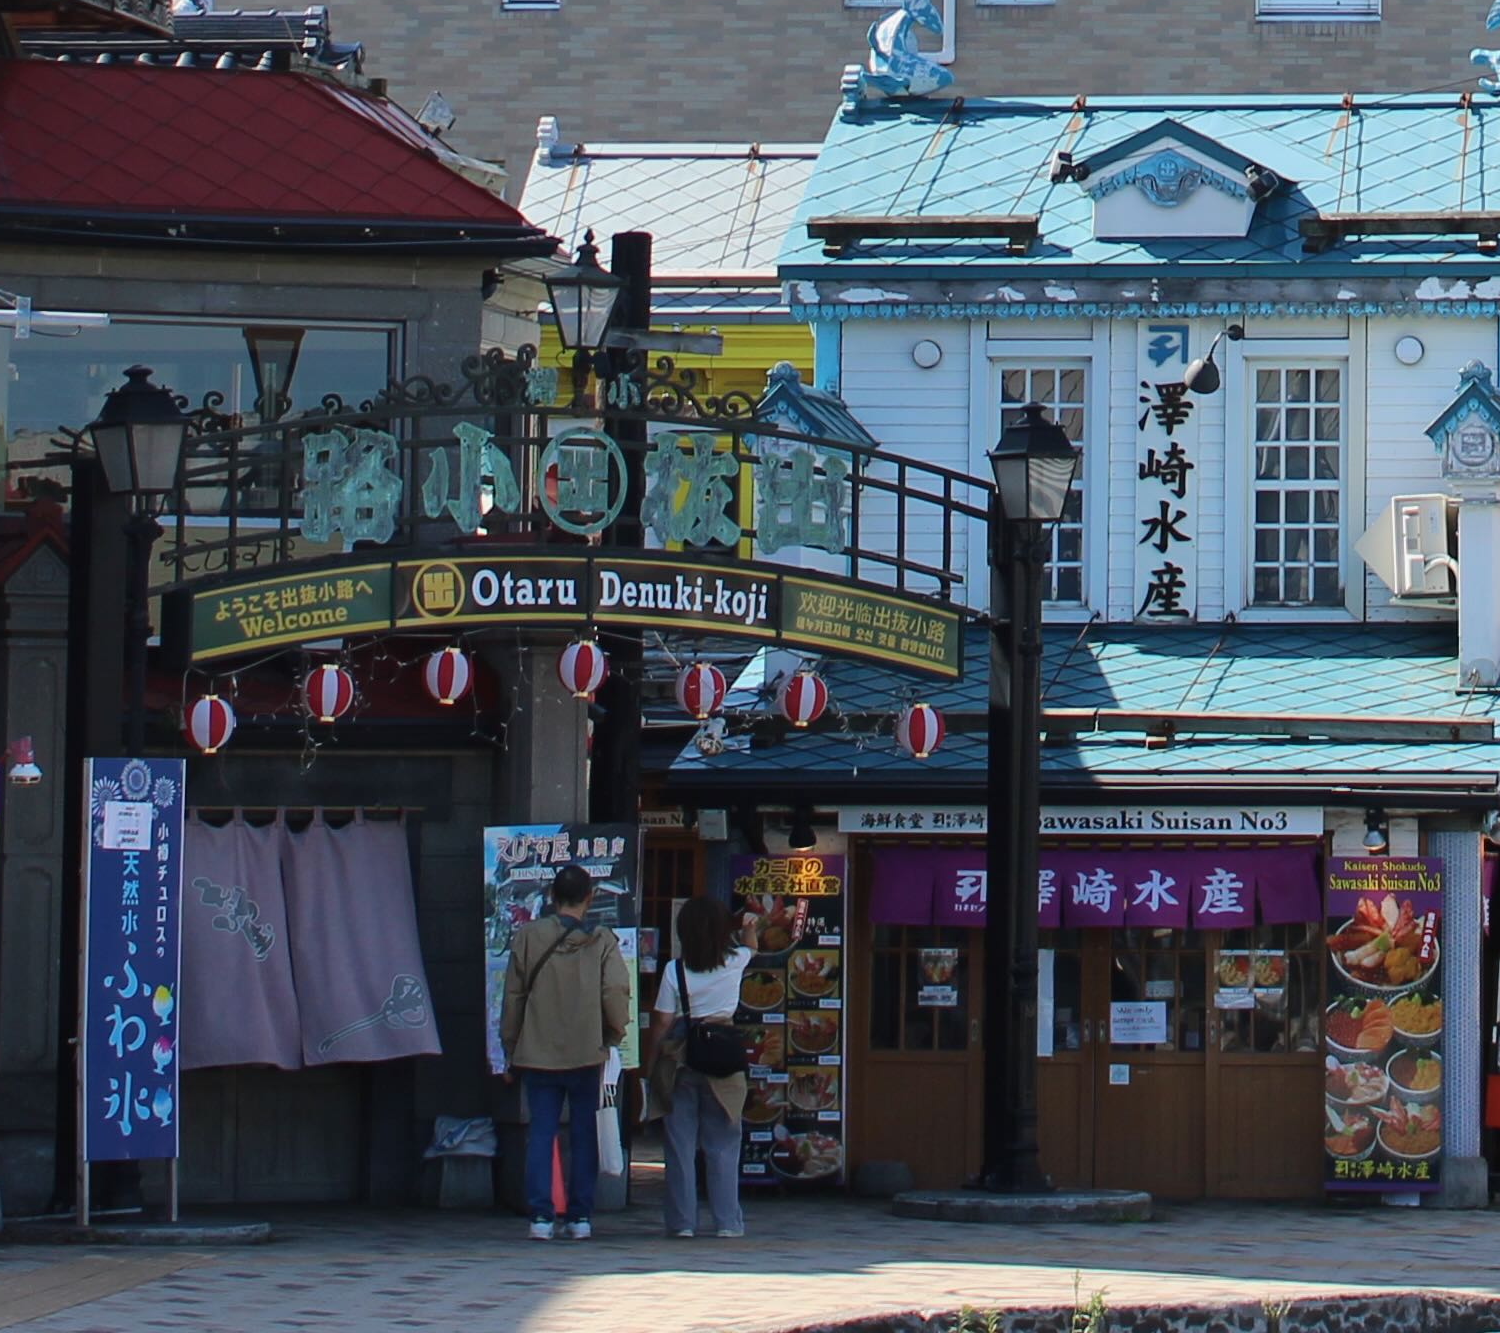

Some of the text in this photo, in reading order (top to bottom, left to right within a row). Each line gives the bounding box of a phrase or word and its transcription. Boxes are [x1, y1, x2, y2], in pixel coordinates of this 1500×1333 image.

[1138, 380, 1194, 617] 澤崎水産
[214, 579, 373, 621] ようこそ出抜小路へ
[471, 569, 768, 625] Otaru Denuki-koji
[240, 605, 348, 638] Welcome
[860, 812, 924, 829] 海鮮食堂
[1151, 811, 1231, 830] Suisan
[1240, 812, 1288, 830] No3
[755, 858, 823, 876] カニ屋の
[1344, 861, 1427, 871] Kaisen Shokudo
[121, 851, 140, 935] 天然水
[734, 875, 840, 895] 水産会社直営
[1330, 874, 1378, 891] Sawasaki
[1381, 874, 1416, 891] Suisan
[103, 941, 150, 1136] ふわ氷
